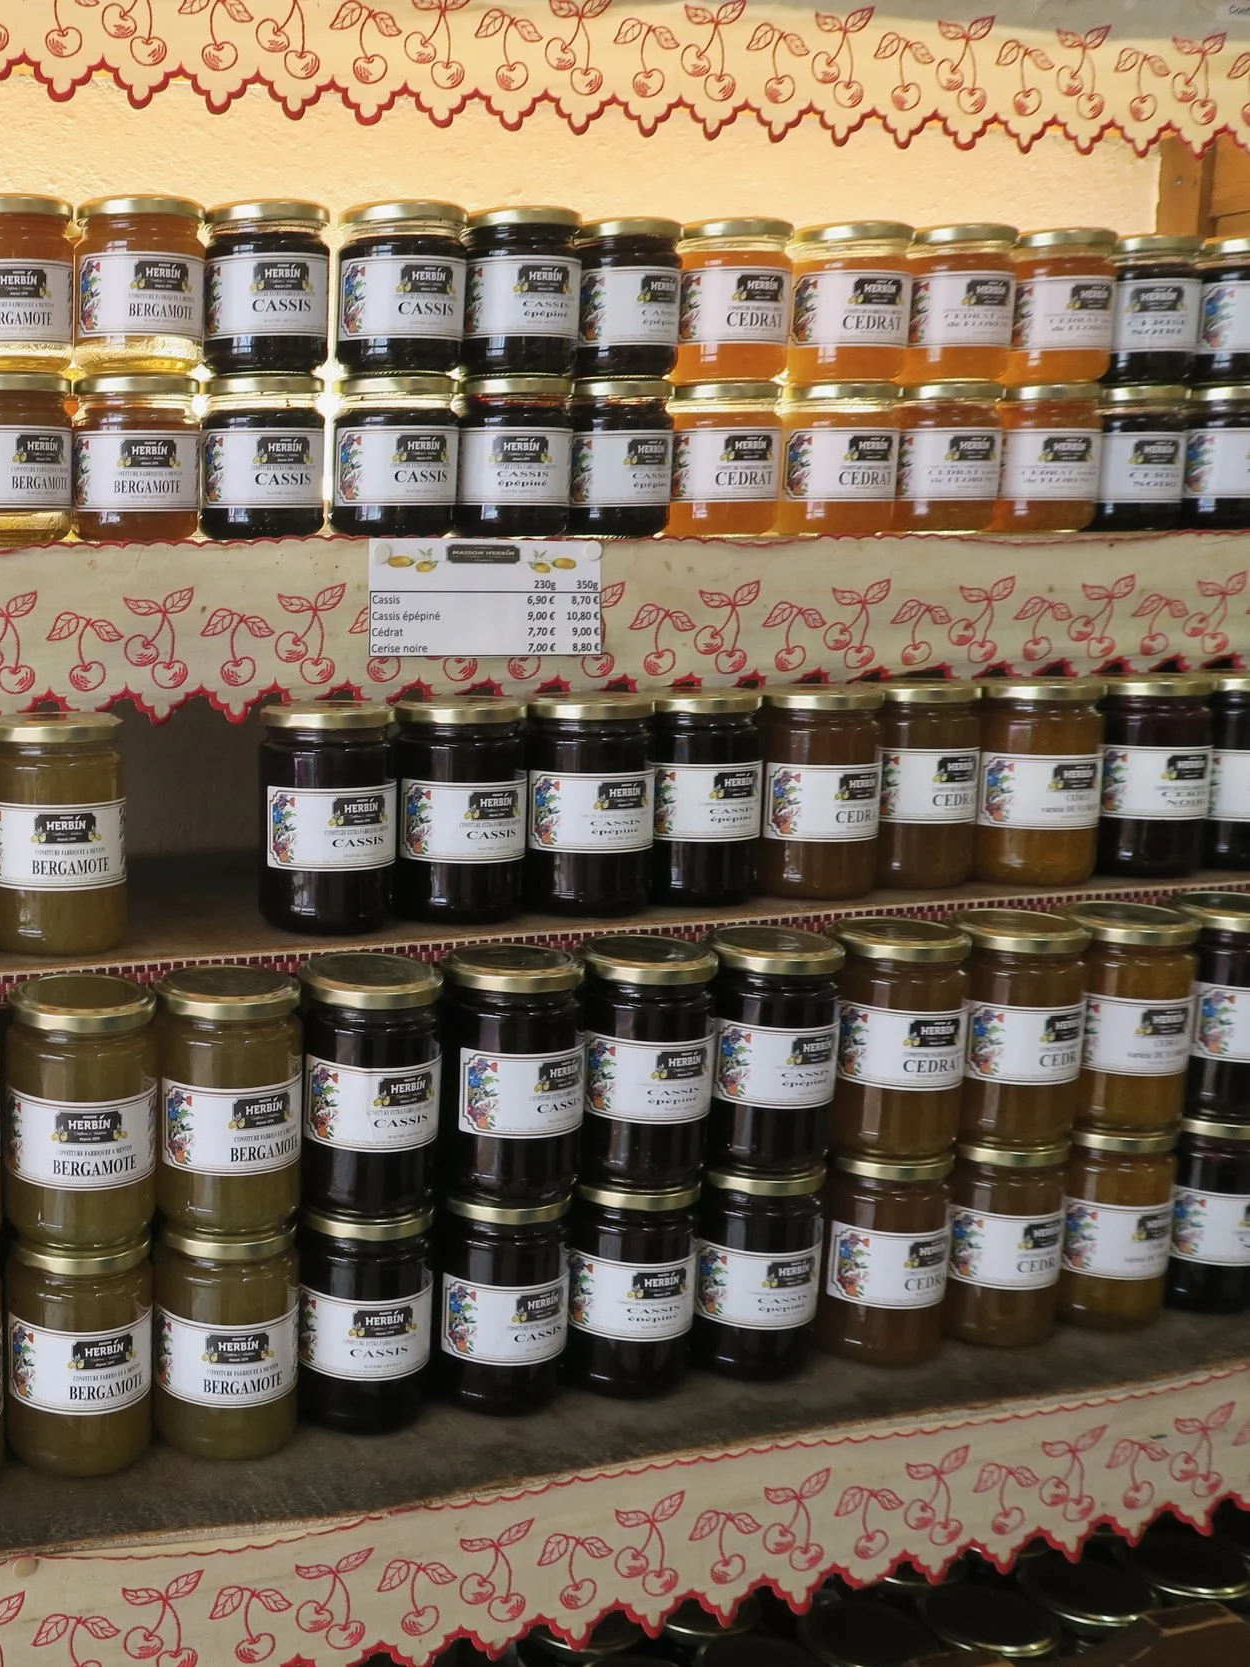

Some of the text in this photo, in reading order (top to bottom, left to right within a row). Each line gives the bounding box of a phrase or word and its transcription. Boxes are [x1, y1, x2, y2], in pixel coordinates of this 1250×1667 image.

[0, 274, 37, 286] HERBIN
[128, 302, 193, 320] BERGAMOTE
[252, 298, 312, 314] CASSIS
[398, 300, 454, 317] CASSIS
[726, 311, 783, 329] CEDRAT
[842, 312, 902, 331] CEDRAT
[132, 444, 168, 456] HERBIN
[254, 471, 311, 486] CASSIS
[394, 469, 448, 484] CASSIS
[714, 469, 773, 487] CEDRAT
[838, 470, 893, 488] CEDRAT
[113, 479, 181, 495] BERGAMOTE
[534, 580, 598, 591] 230g 350g
[372, 595, 599, 606] Cassis 6,90 € 8,70 €
[372, 611, 600, 623] Cassis épépiné 9,00 € 10,80 €
[371, 627, 600, 638] Cédrat 7,70 € 9,00 €
[371, 643, 600, 654] Cerise noire 7,00 € 8,80 €
[45, 818, 87, 832] HERBIN
[466, 827, 516, 841] CASSIS
[331, 835, 384, 849] CASSIS
[32, 857, 110, 876] BERGAMOTE
[68, 1119, 111, 1130] HERBIN
[373, 1112, 428, 1129] CASSIS
[230, 1136, 299, 1163] BERGAMOTE
[53, 1154, 137, 1177] BERGAMOTE
[218, 1338, 259, 1353] HERBIN
[350, 1345, 409, 1360] CASSIS
[69, 1371, 143, 1401] BERGAMOTE
[203, 1372, 282, 1396] BERGAMOTE
